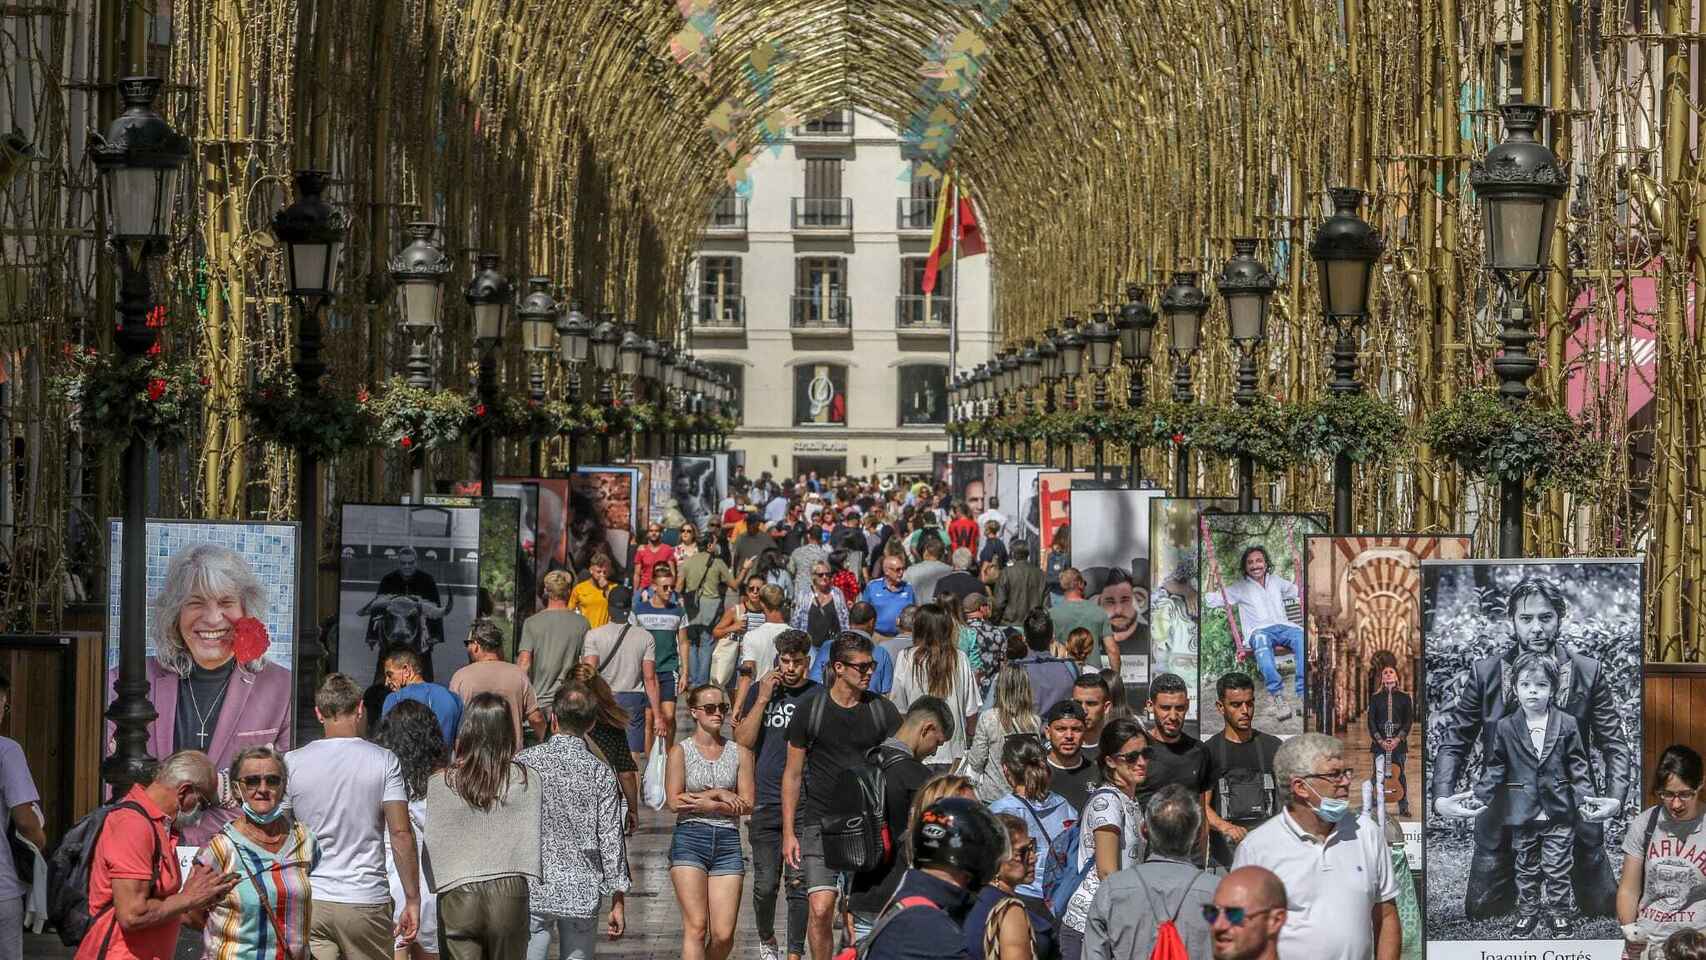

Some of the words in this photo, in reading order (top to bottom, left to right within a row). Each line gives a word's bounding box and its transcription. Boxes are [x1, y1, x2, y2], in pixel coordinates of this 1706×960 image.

[764, 702, 796, 716] JAC
[1647, 839, 1706, 877] ARVAR
[1542, 950, 1592, 960] Cortés
